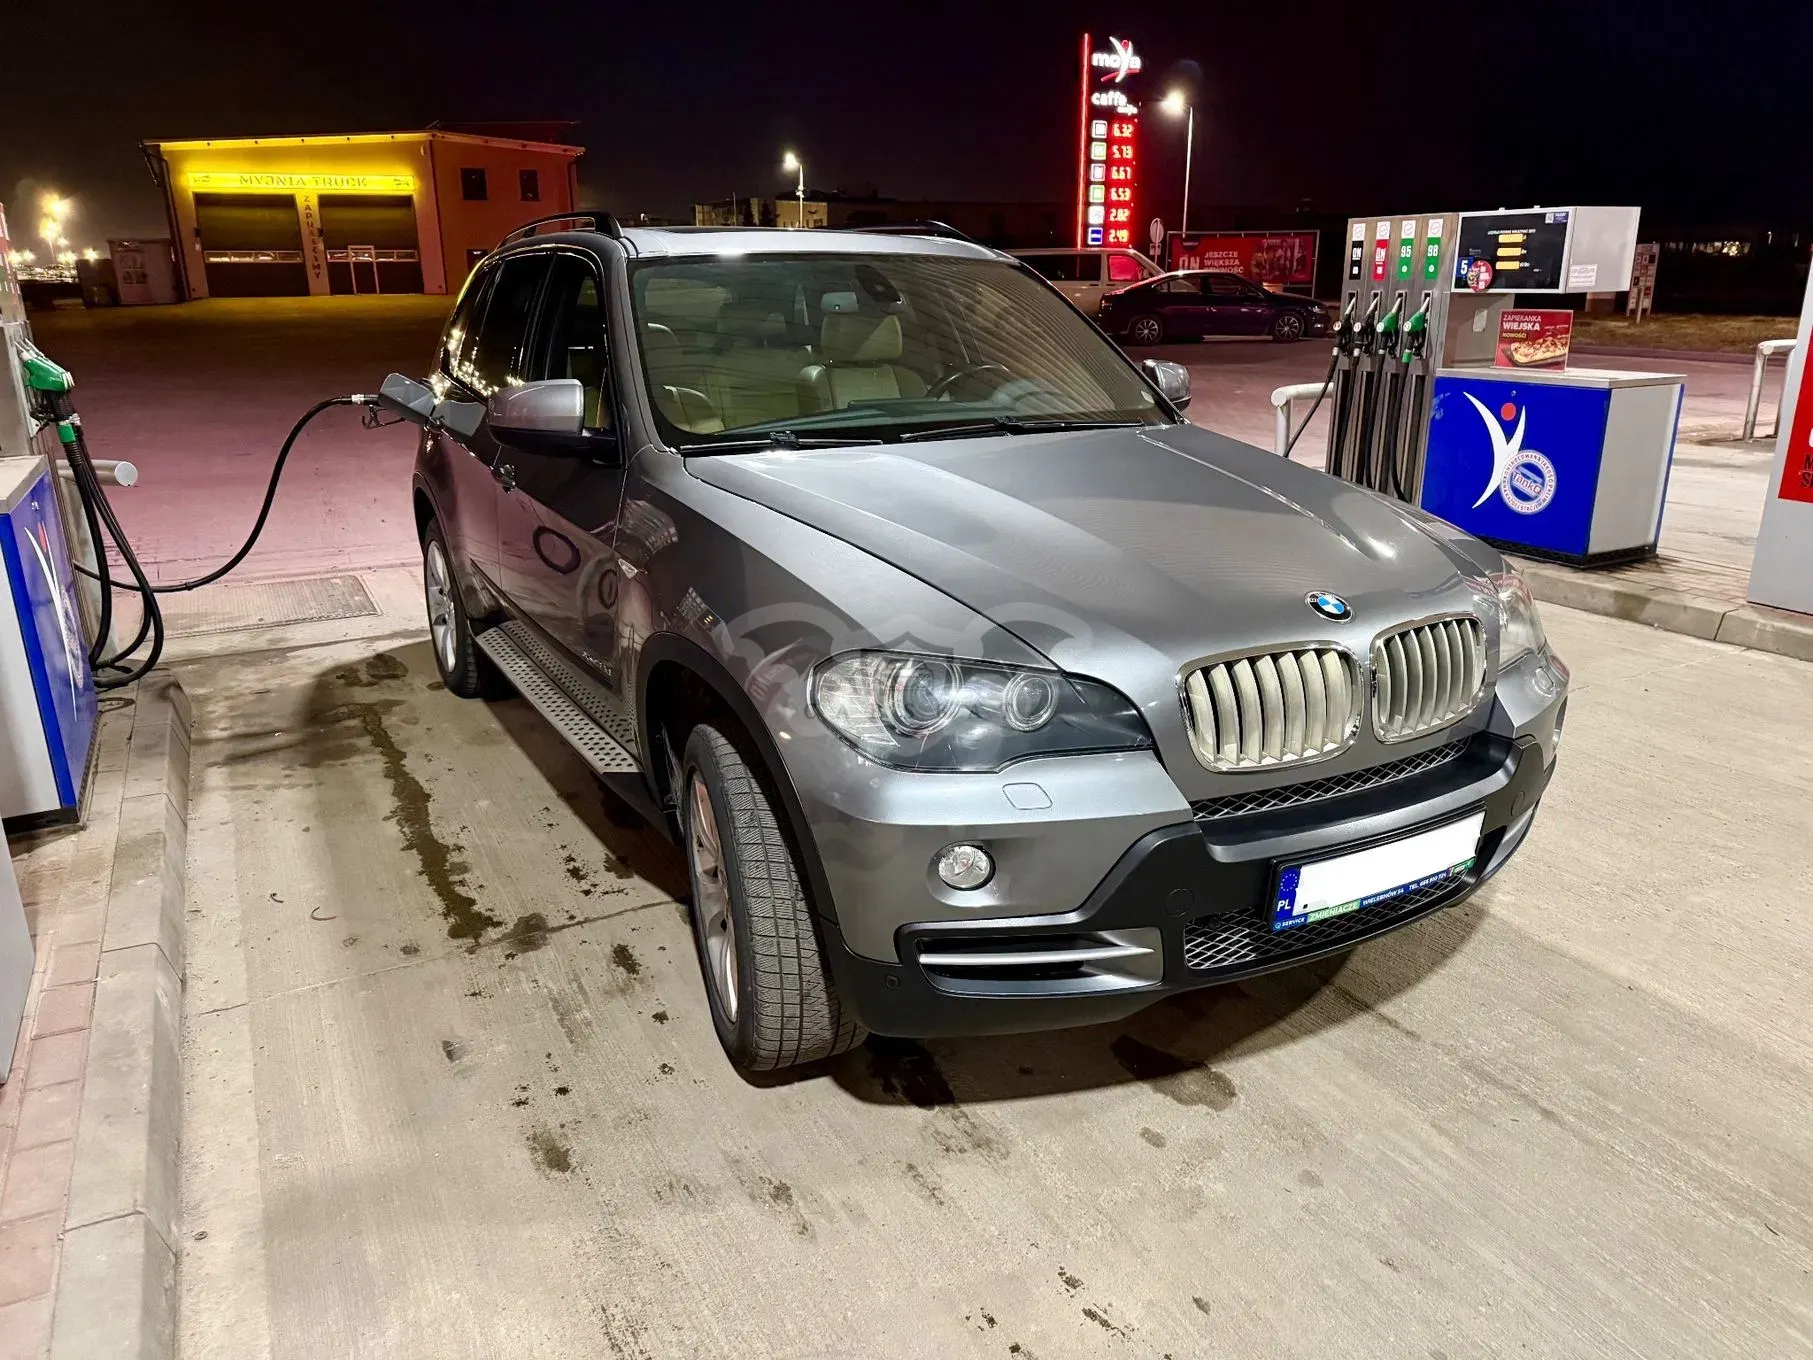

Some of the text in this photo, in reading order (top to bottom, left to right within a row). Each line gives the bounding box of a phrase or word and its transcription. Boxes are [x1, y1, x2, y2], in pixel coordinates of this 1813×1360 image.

[240, 175, 367, 188] MYJNIA TRUCK
[1401, 245, 1412, 258] 95
[1427, 244, 1439, 257] 98
[1460, 259, 1469, 275] 5
[1503, 314, 1541, 322] ZAPIEKANKA
[1502, 321, 1541, 331] WIEJSKA
[1277, 898, 1291, 912] PL
[1282, 917, 1306, 927] SERVICE
